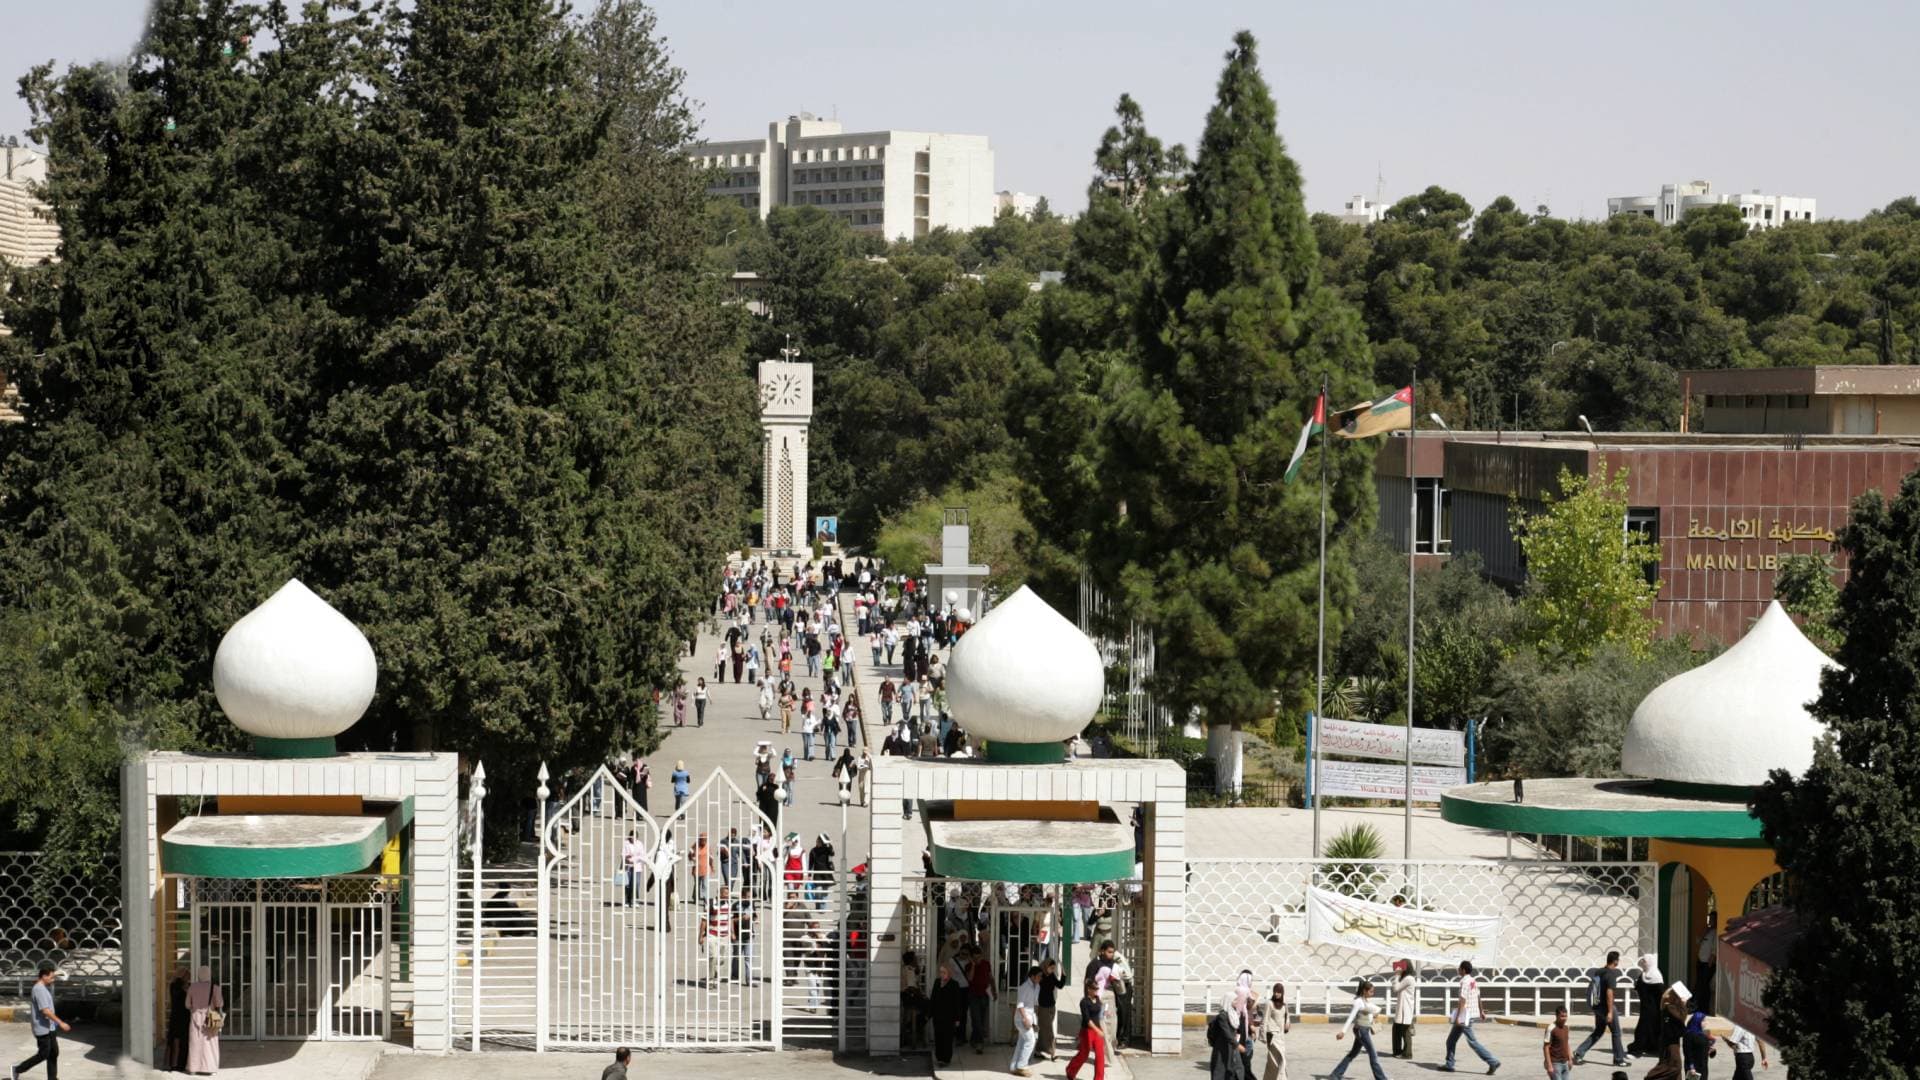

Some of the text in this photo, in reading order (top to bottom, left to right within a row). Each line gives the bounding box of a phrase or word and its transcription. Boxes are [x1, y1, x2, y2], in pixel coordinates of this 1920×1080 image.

[1687, 518, 1836, 546] مكتبة الجامعة
[1686, 553, 1737, 571] MAIN
[1389, 786, 1408, 796] Trave
[1332, 911, 1390, 935] المستعمل
[1379, 922, 1427, 943] الكتاب
[1426, 927, 1477, 952] معرض
